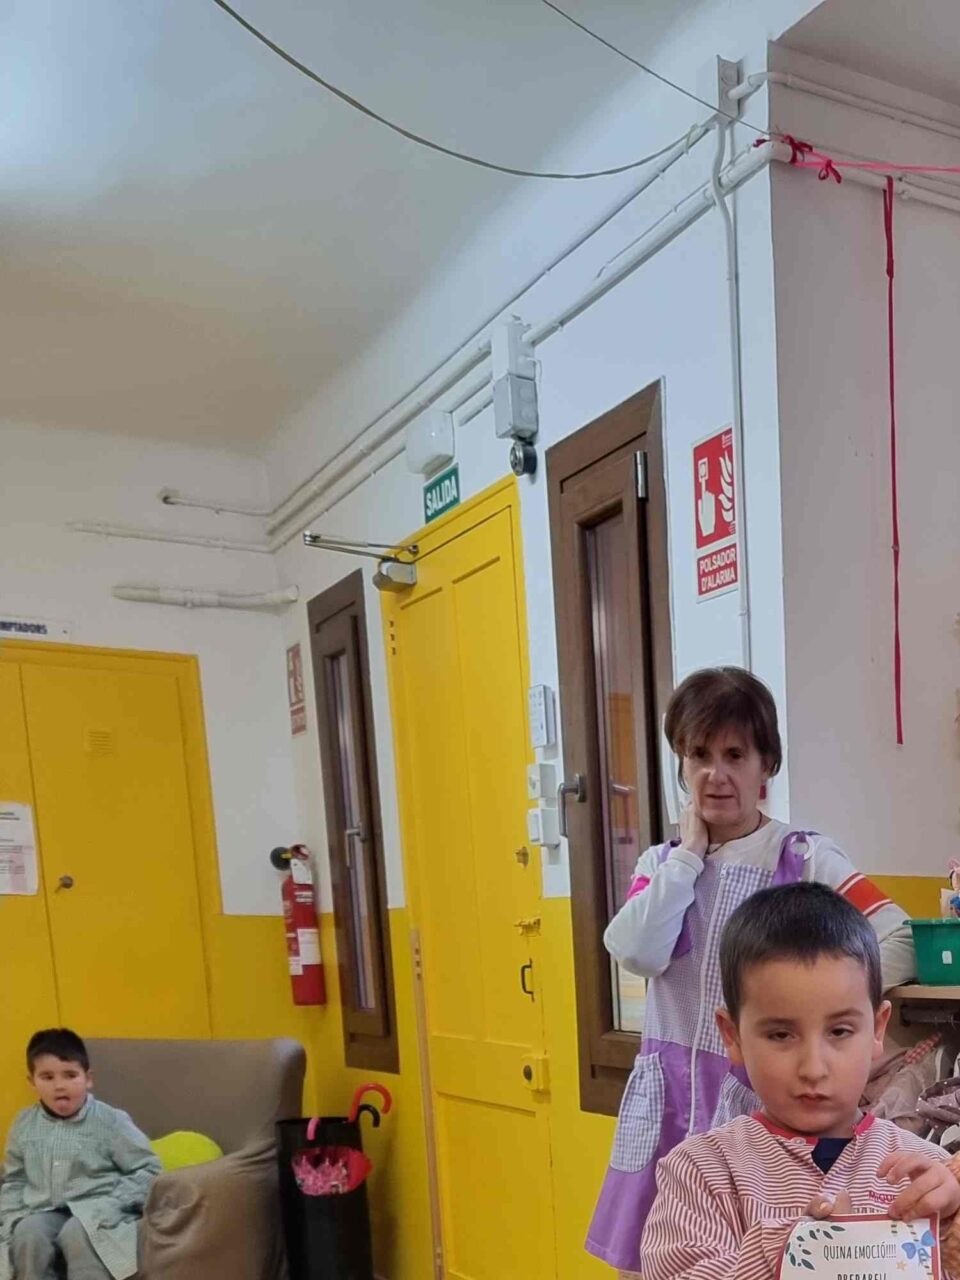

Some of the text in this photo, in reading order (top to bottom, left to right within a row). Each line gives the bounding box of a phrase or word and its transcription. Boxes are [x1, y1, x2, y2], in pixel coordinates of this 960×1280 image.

[426, 475, 458, 516] SALIDA
[700, 547, 736, 576] POLSADOR
[702, 565, 736, 592] D'ALARMA
[823, 1244, 852, 1261] QUINA
